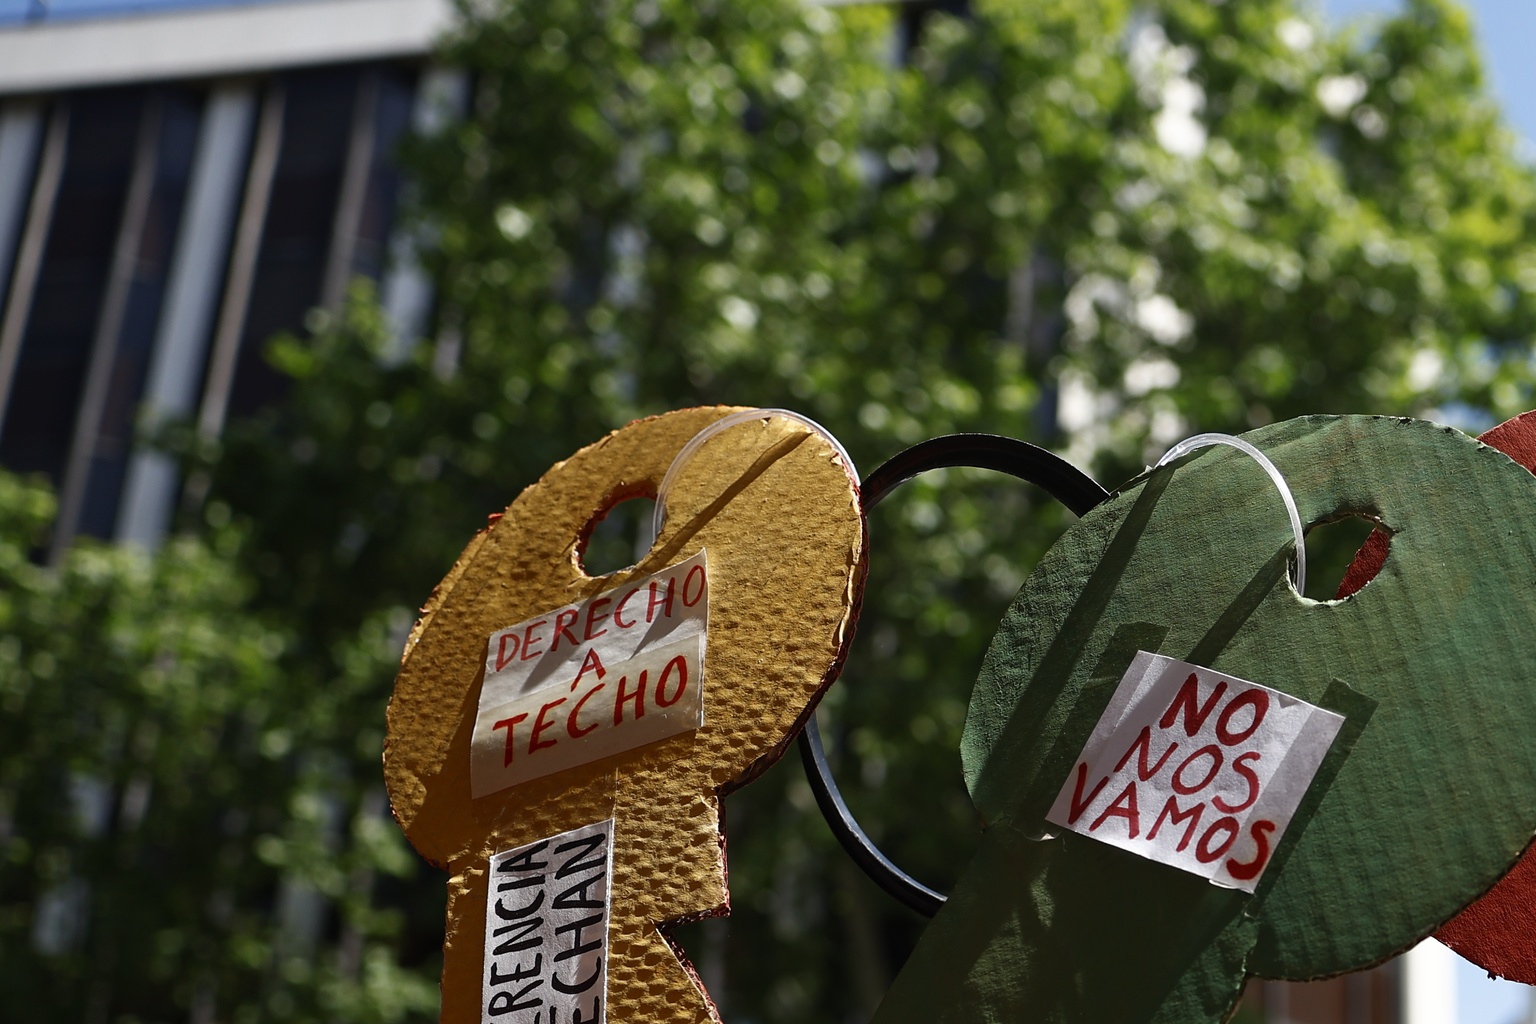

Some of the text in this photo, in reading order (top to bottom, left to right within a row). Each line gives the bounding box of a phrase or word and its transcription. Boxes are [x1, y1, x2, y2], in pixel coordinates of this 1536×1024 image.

[495, 565, 706, 672] DERECHO
[492, 655, 688, 769] TECHO
[570, 647, 607, 692] A
[1159, 672, 1269, 746] NO
[1113, 725, 1260, 814] NOS
[1067, 761, 1276, 880] VAMOS
